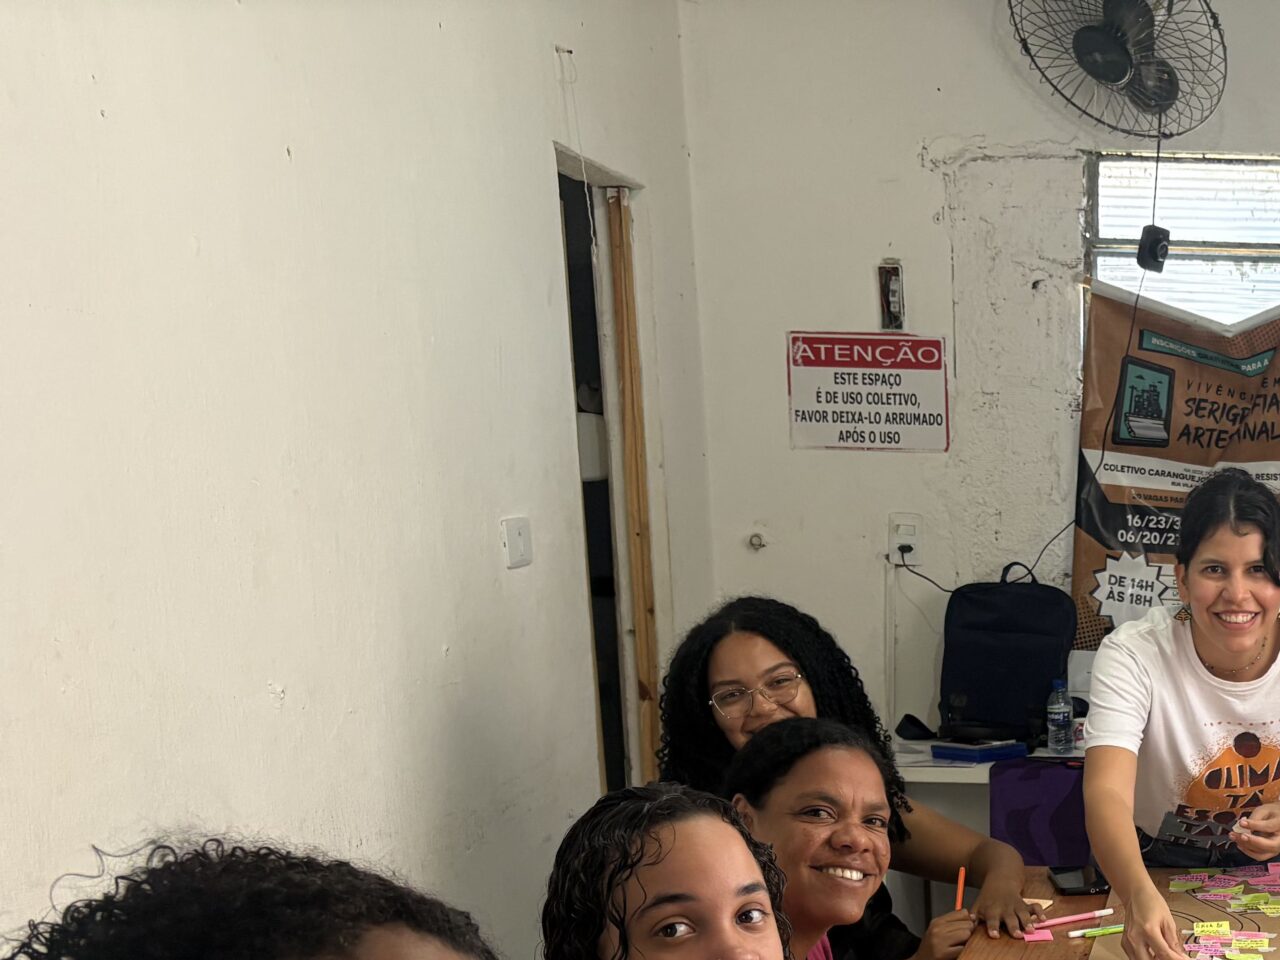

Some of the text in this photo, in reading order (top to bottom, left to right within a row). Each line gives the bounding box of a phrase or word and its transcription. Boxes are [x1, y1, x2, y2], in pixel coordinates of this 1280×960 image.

[796, 341, 939, 366] ATENÇÃO
[1241, 361, 1262, 372] PARA
[834, 372, 902, 389] ESTE ESPAÇO
[816, 387, 921, 408] É DE USO COLETIVO,
[795, 410, 943, 426] FAVOR DEIXA-LO ARRUMADO
[838, 427, 901, 444] APÓS O USO
[1103, 463, 1146, 476] COLETIVO
[1126, 514, 1182, 530] 16/23/3
[1107, 574, 1155, 593] DE 14H
[1106, 587, 1153, 608] ÀS 18H
